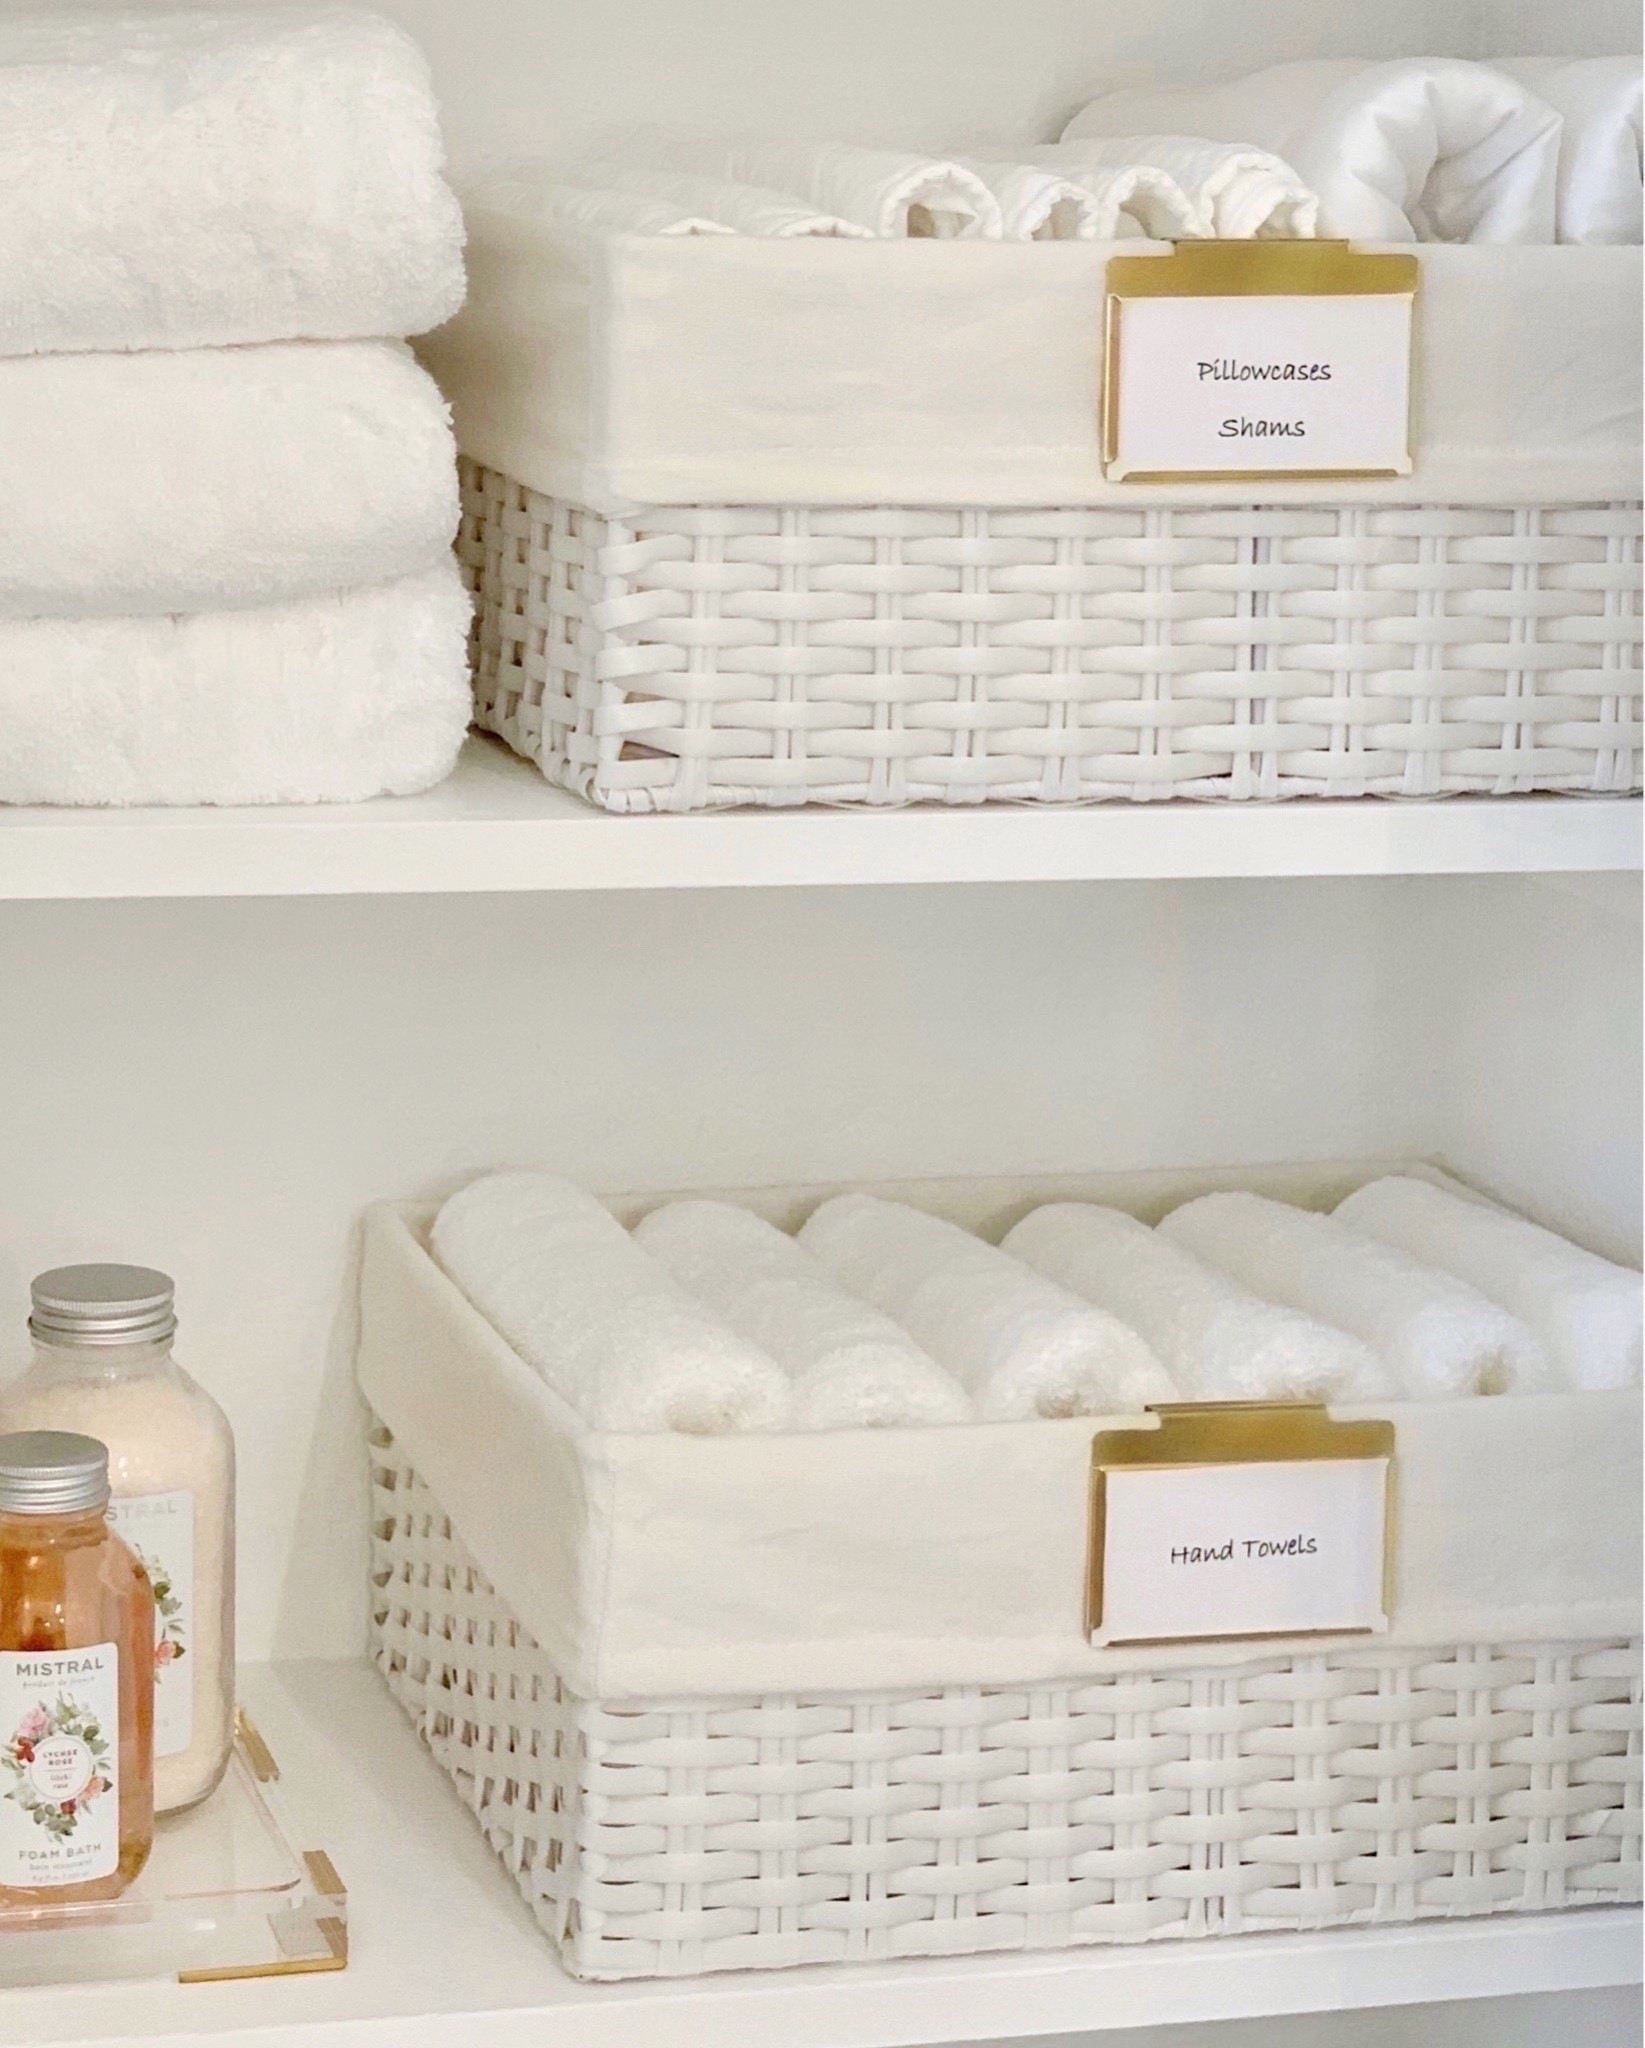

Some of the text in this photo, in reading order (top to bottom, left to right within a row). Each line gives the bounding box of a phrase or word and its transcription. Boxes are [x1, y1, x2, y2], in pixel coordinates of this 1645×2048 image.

[1197, 358, 1332, 381] Pillowcases
[1218, 416, 1306, 438] Shams
[106, 1499, 177, 1521] STRAL
[1171, 1533, 1318, 1565] Hand Towels
[16, 1657, 104, 1676] MISTRAL
[18, 1843, 101, 1860] FOAM BATH
